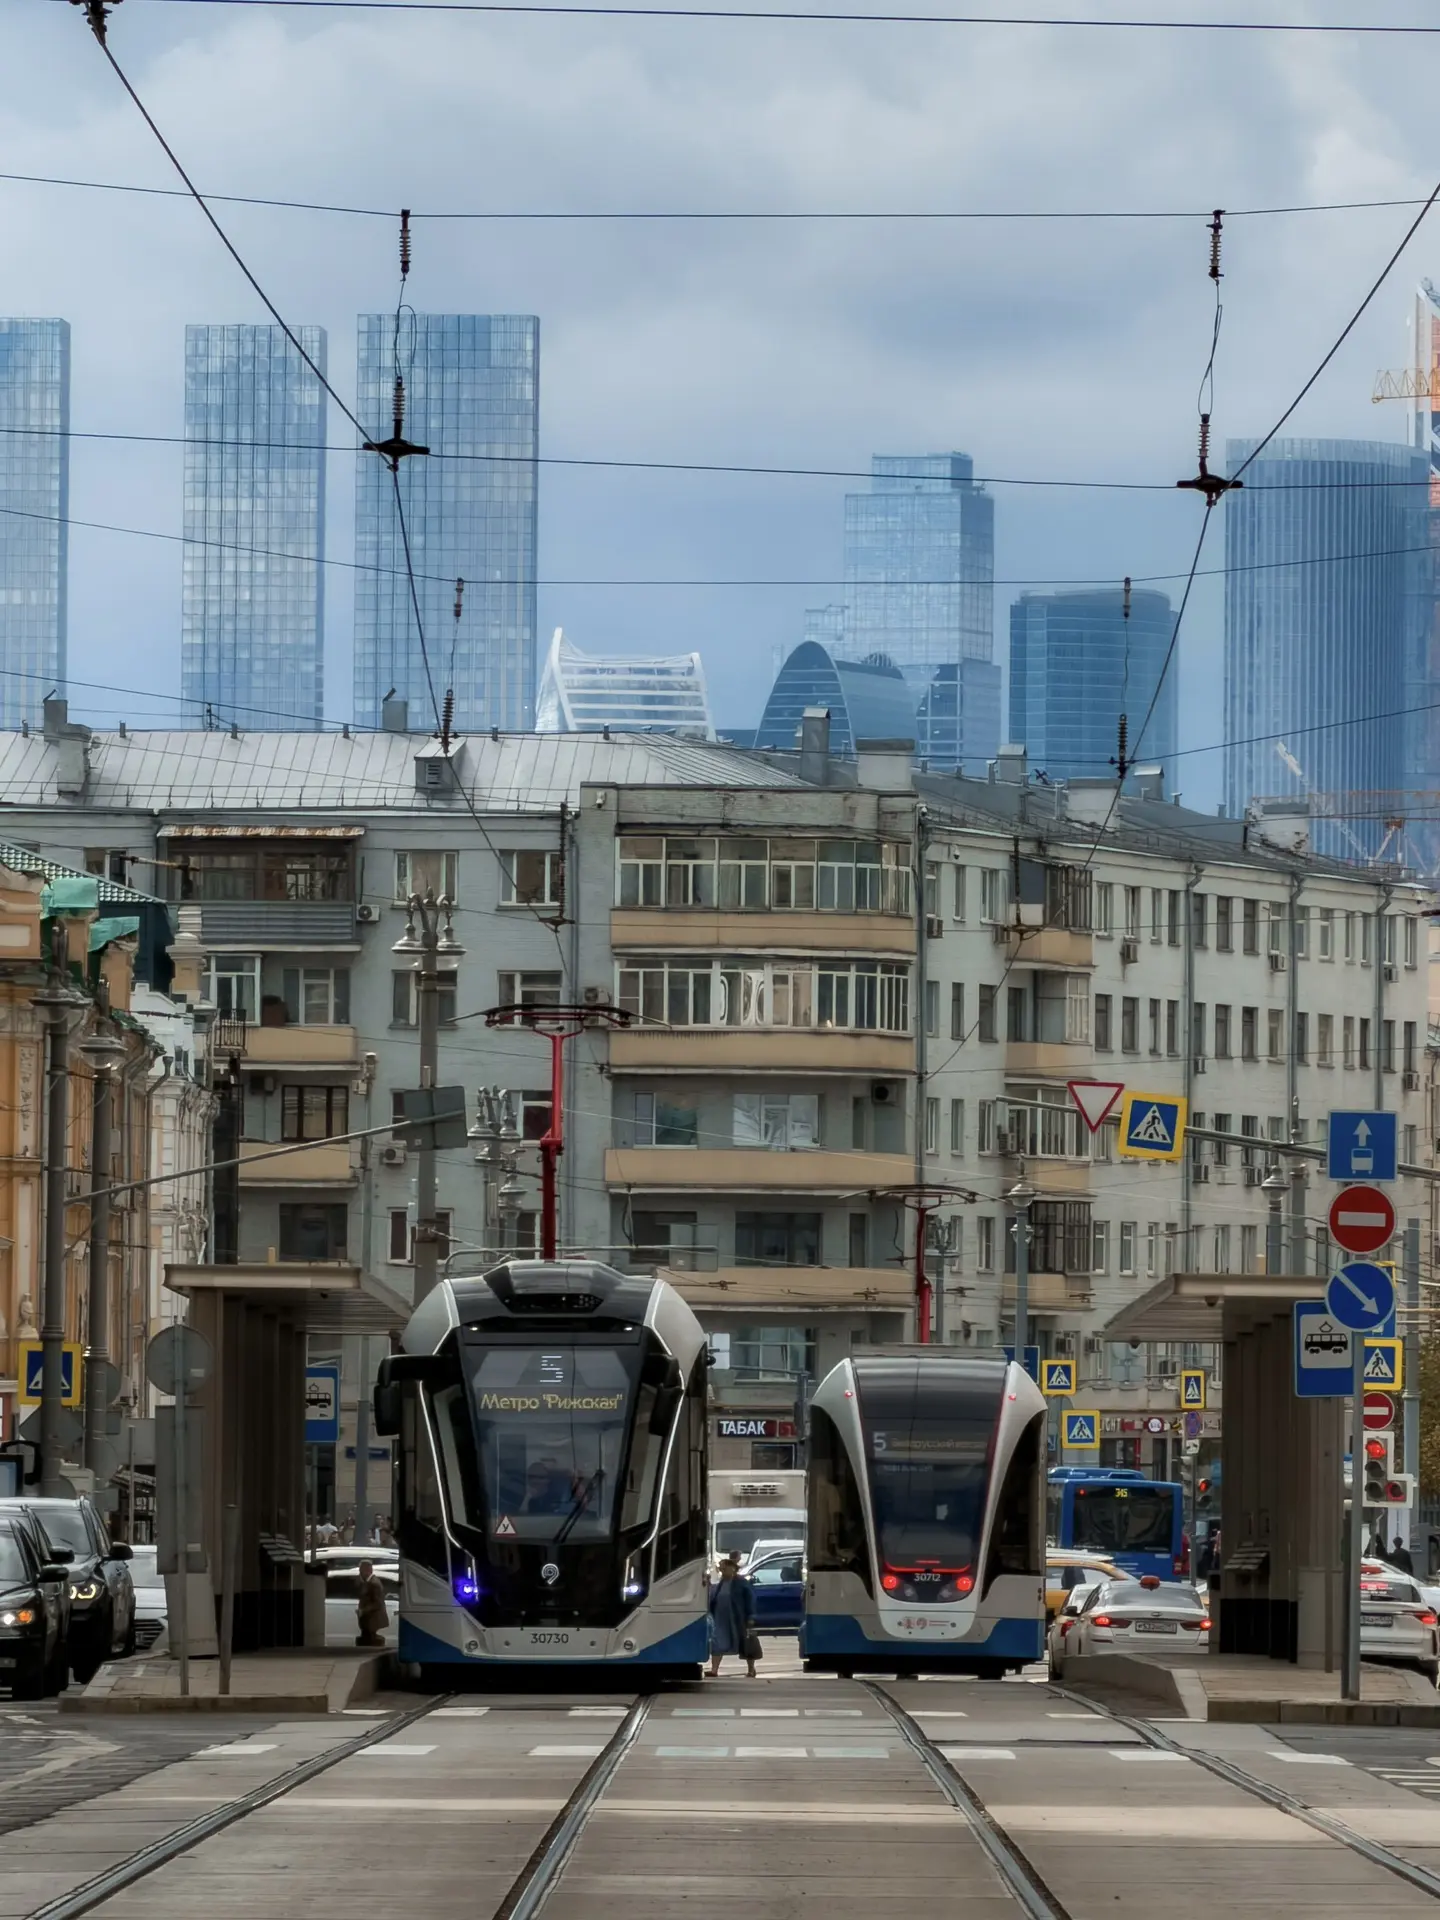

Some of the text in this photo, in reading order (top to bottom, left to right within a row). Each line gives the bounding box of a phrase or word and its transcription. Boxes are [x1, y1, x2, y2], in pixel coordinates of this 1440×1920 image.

[539, 1355, 564, 1383] 5
[480, 1393, 540, 1412] Метро
[719, 1420, 767, 1435] ТАБАК
[873, 1432, 887, 1451] 5
[914, 1572, 941, 1582] 30712
[530, 1633, 570, 1644] 30730
